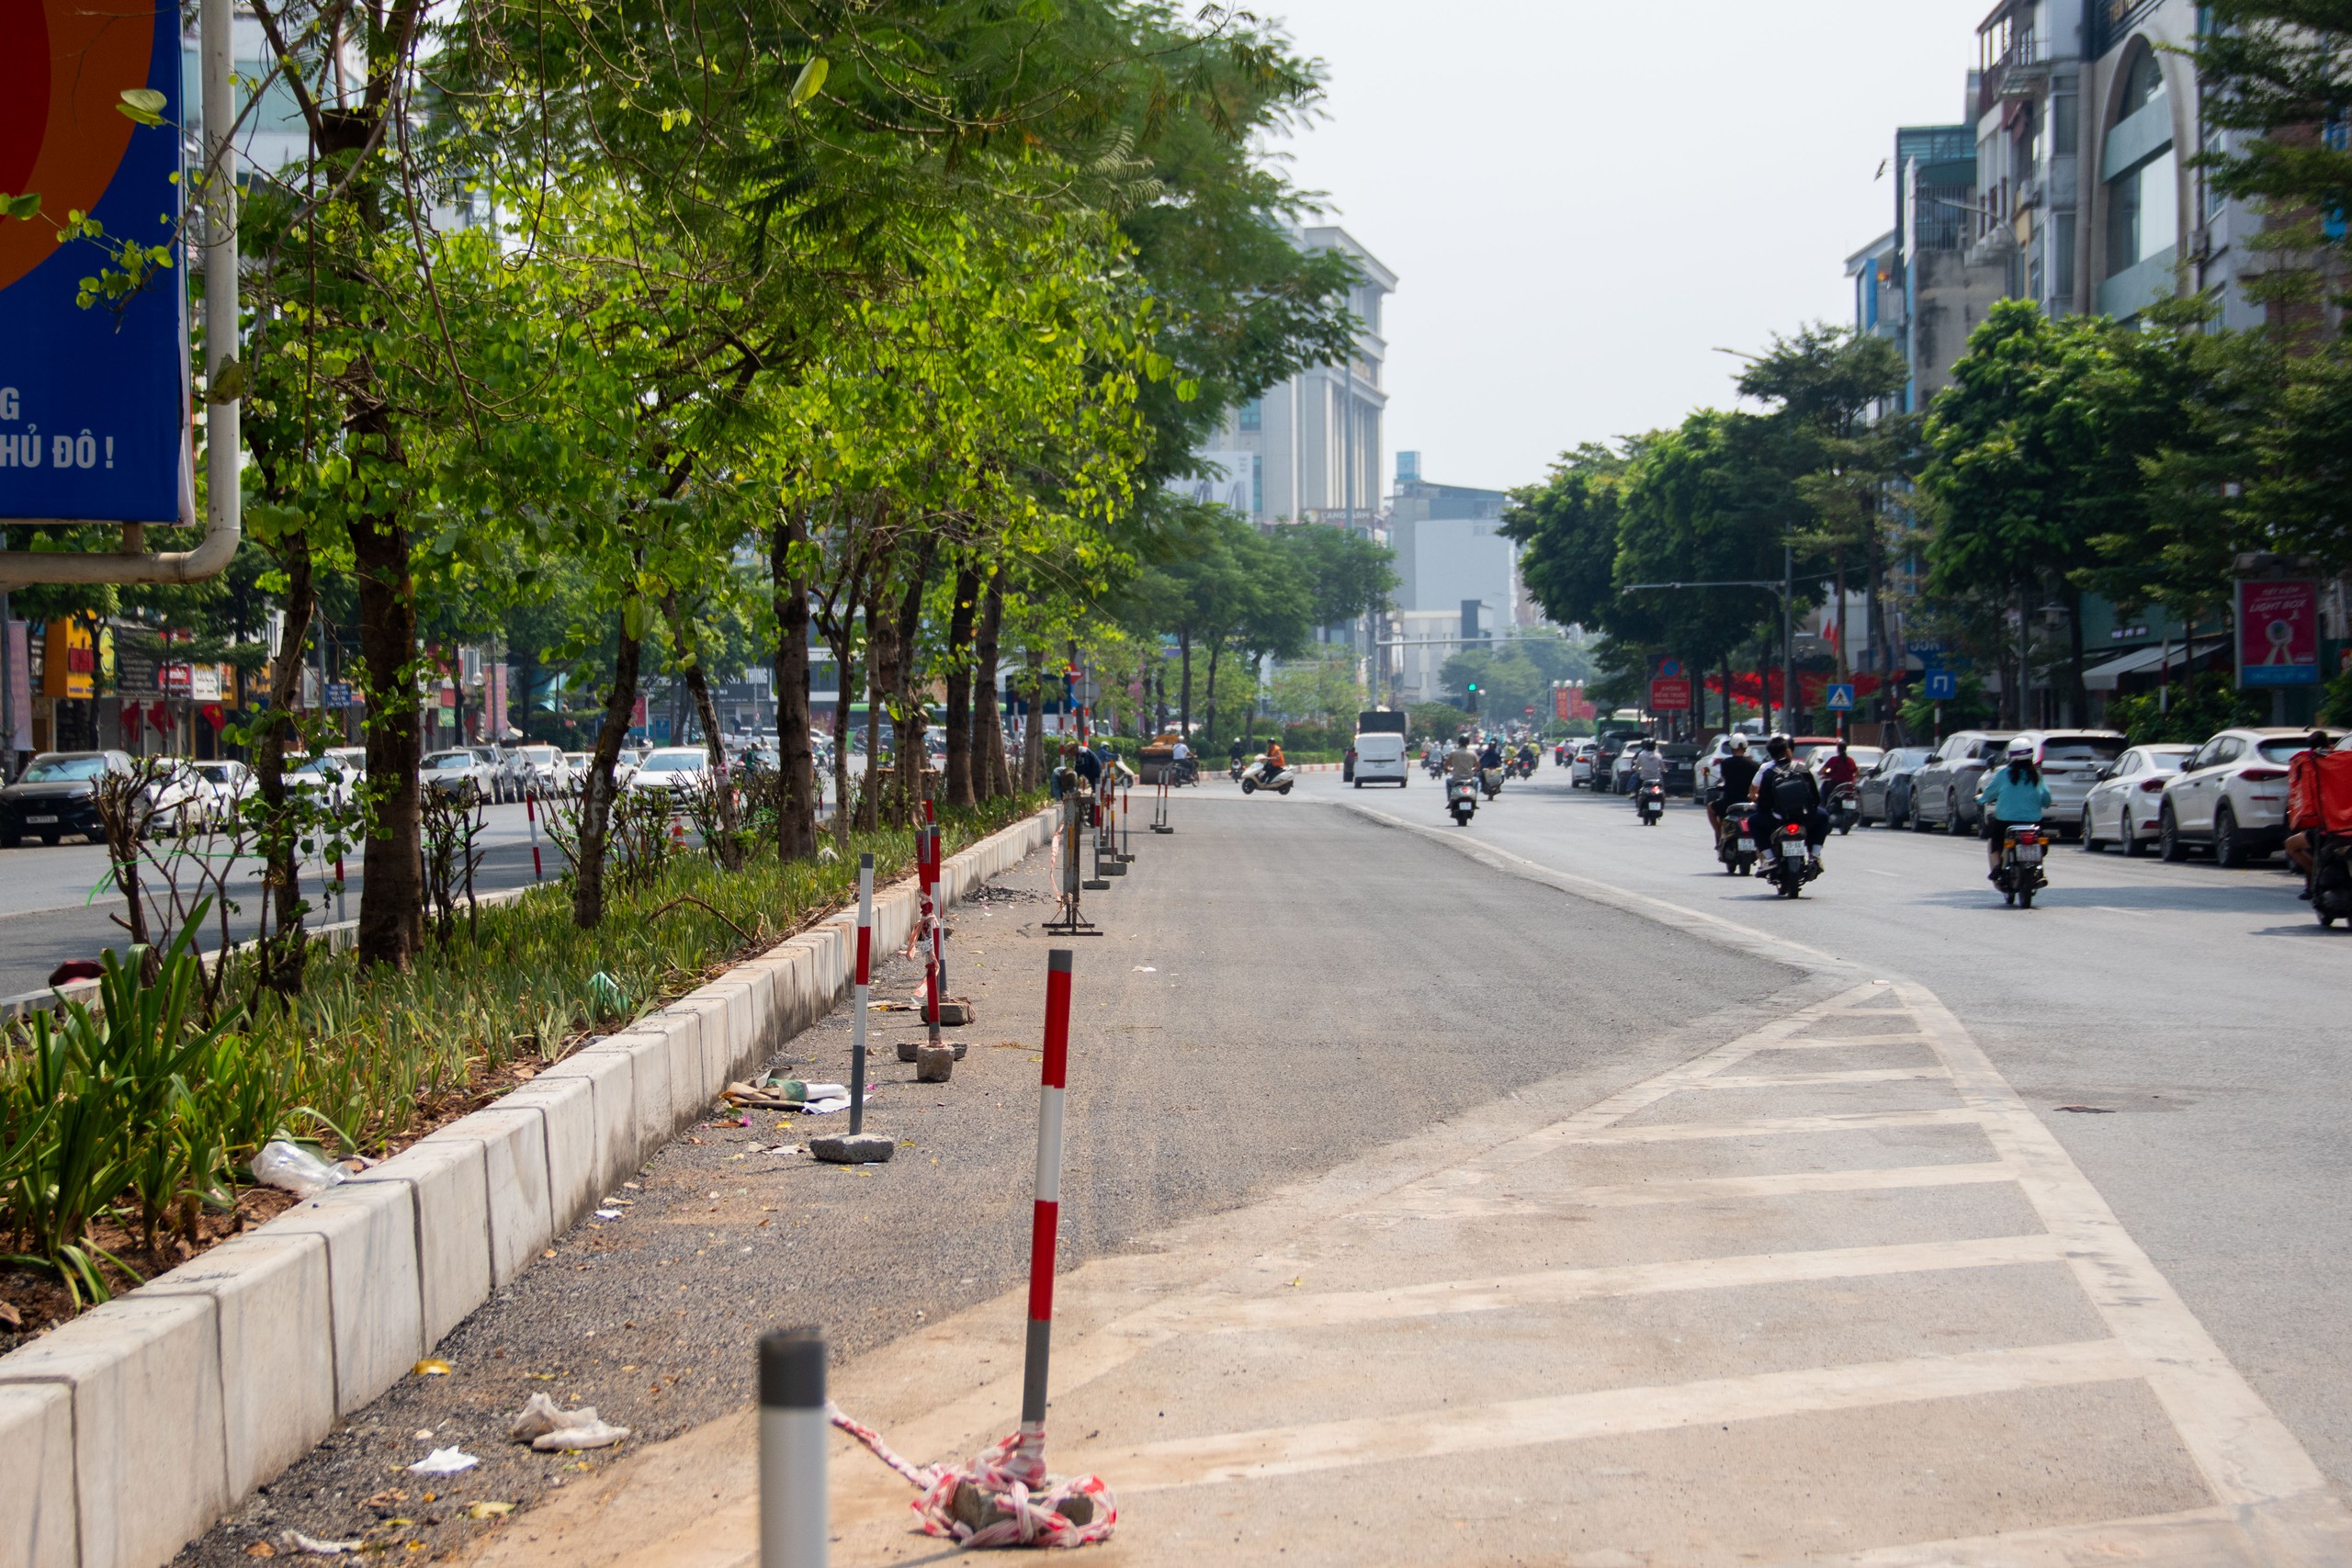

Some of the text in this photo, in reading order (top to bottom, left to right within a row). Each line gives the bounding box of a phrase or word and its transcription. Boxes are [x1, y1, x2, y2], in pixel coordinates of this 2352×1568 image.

[52, 428, 96, 469] ĐÔ
[2248, 598, 2309, 613] LIGHT BOX
